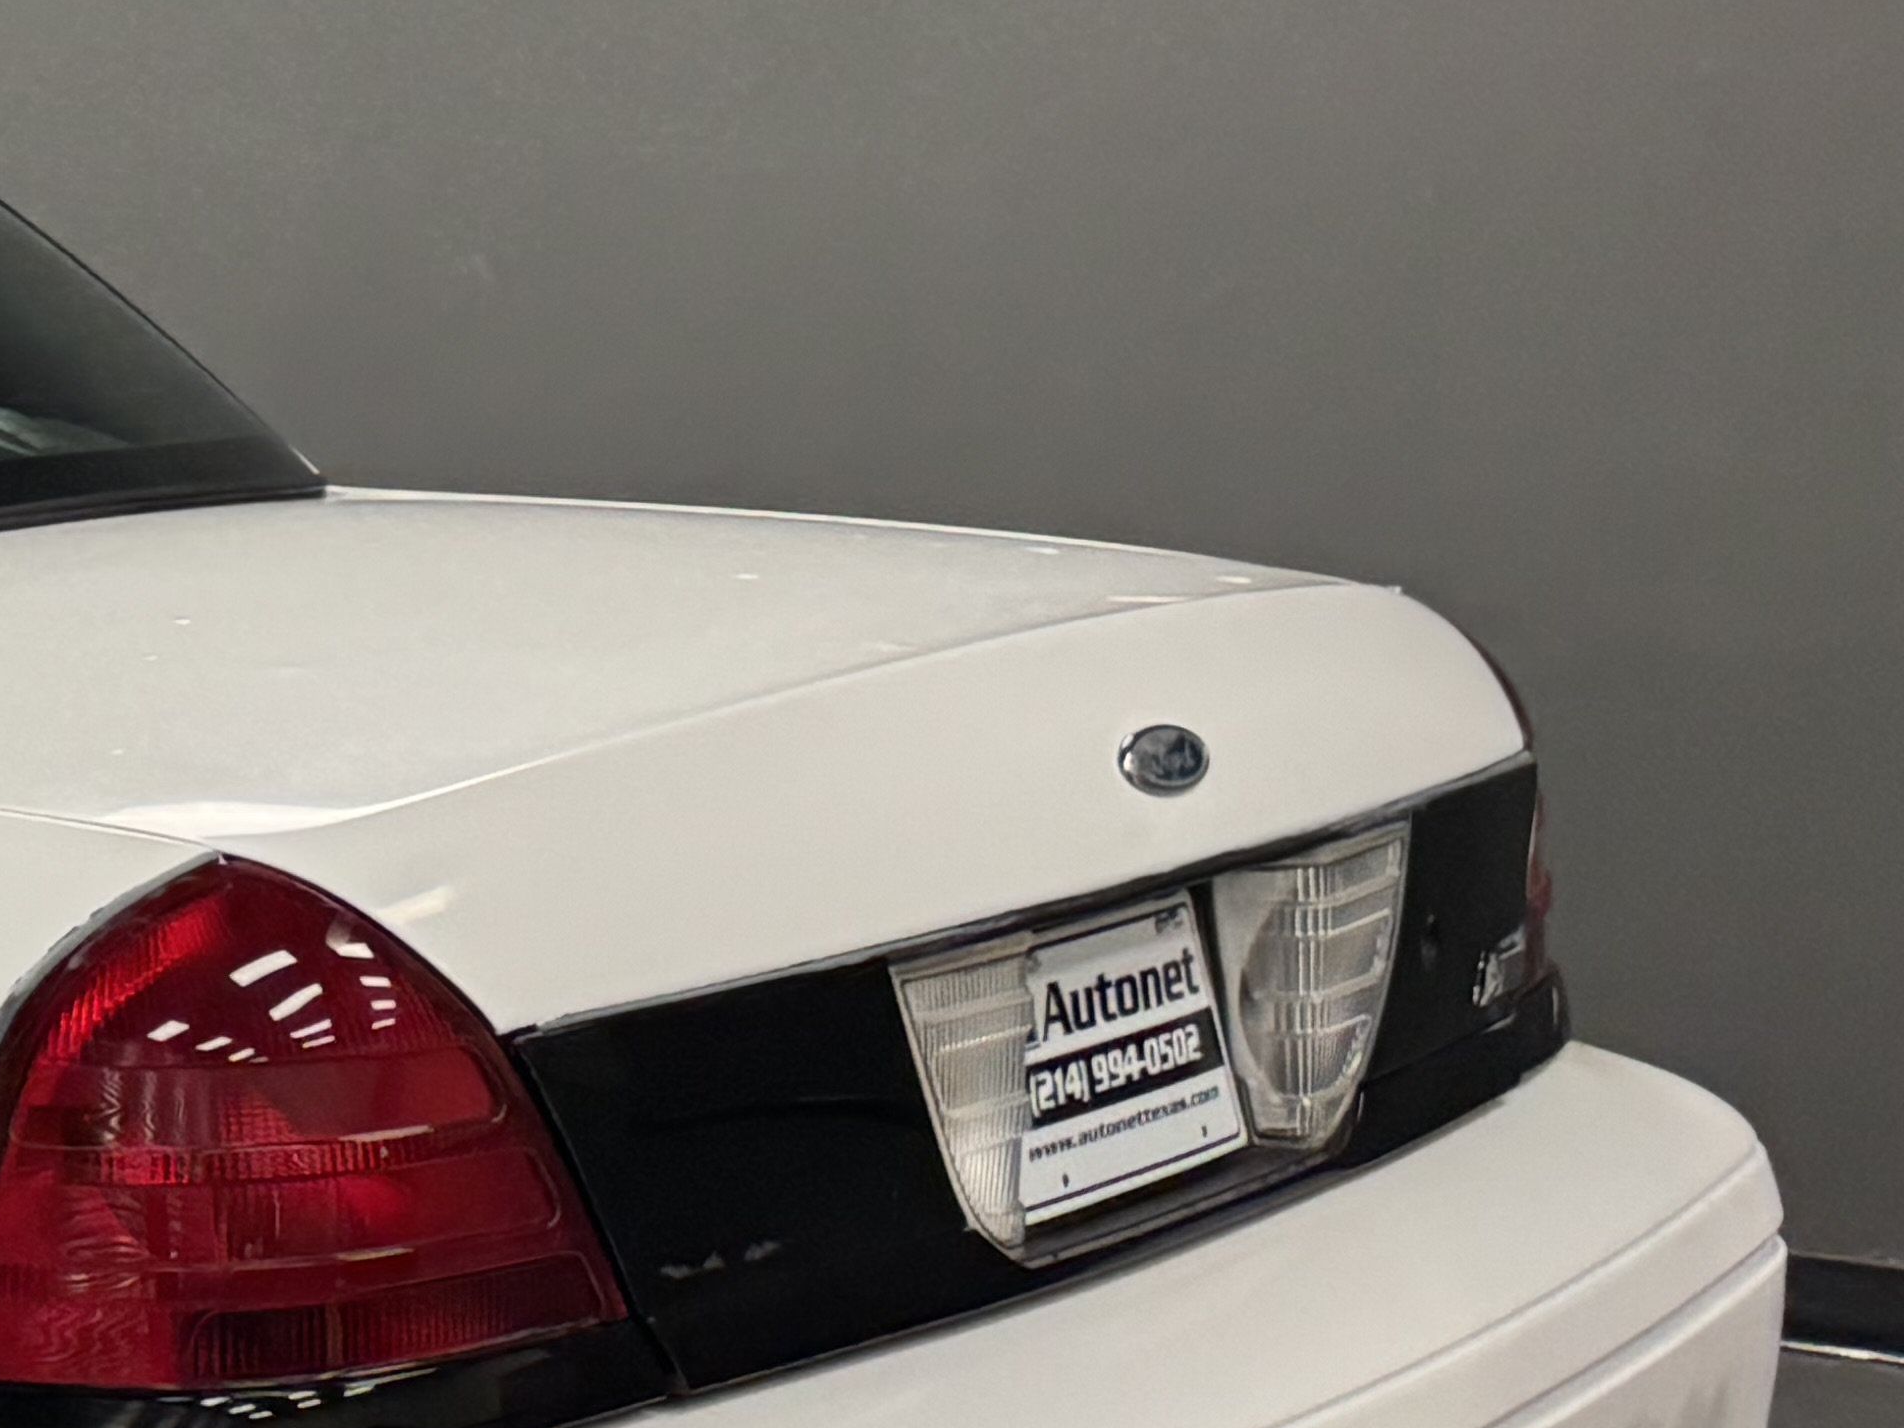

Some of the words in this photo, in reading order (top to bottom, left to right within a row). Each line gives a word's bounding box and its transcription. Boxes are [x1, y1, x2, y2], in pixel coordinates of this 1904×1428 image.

[1043, 948, 1199, 1042] Autonet
[1029, 1060, 1090, 1118] (214)
[1091, 1024, 1202, 1092] 994-0502
